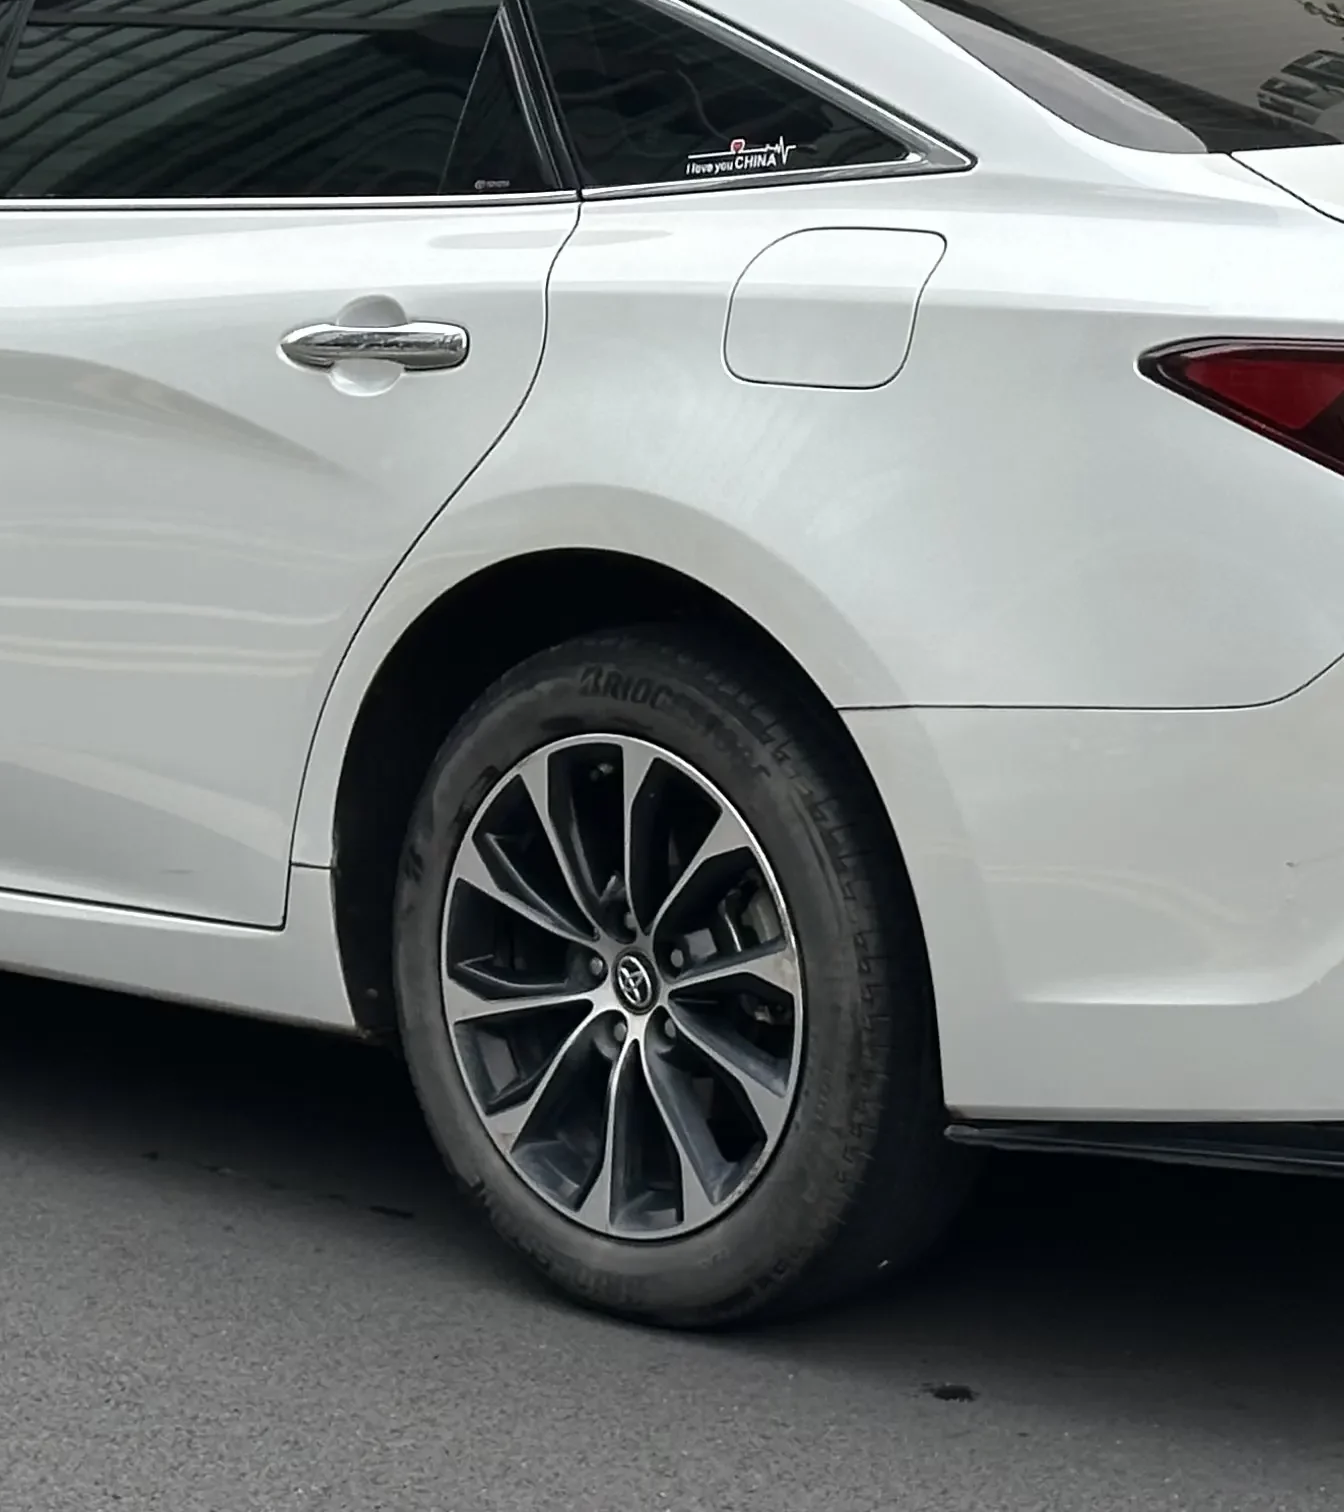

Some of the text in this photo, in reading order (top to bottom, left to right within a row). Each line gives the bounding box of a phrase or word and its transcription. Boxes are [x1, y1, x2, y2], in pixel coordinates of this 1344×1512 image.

[685, 153, 777, 175] I love you CHINA
